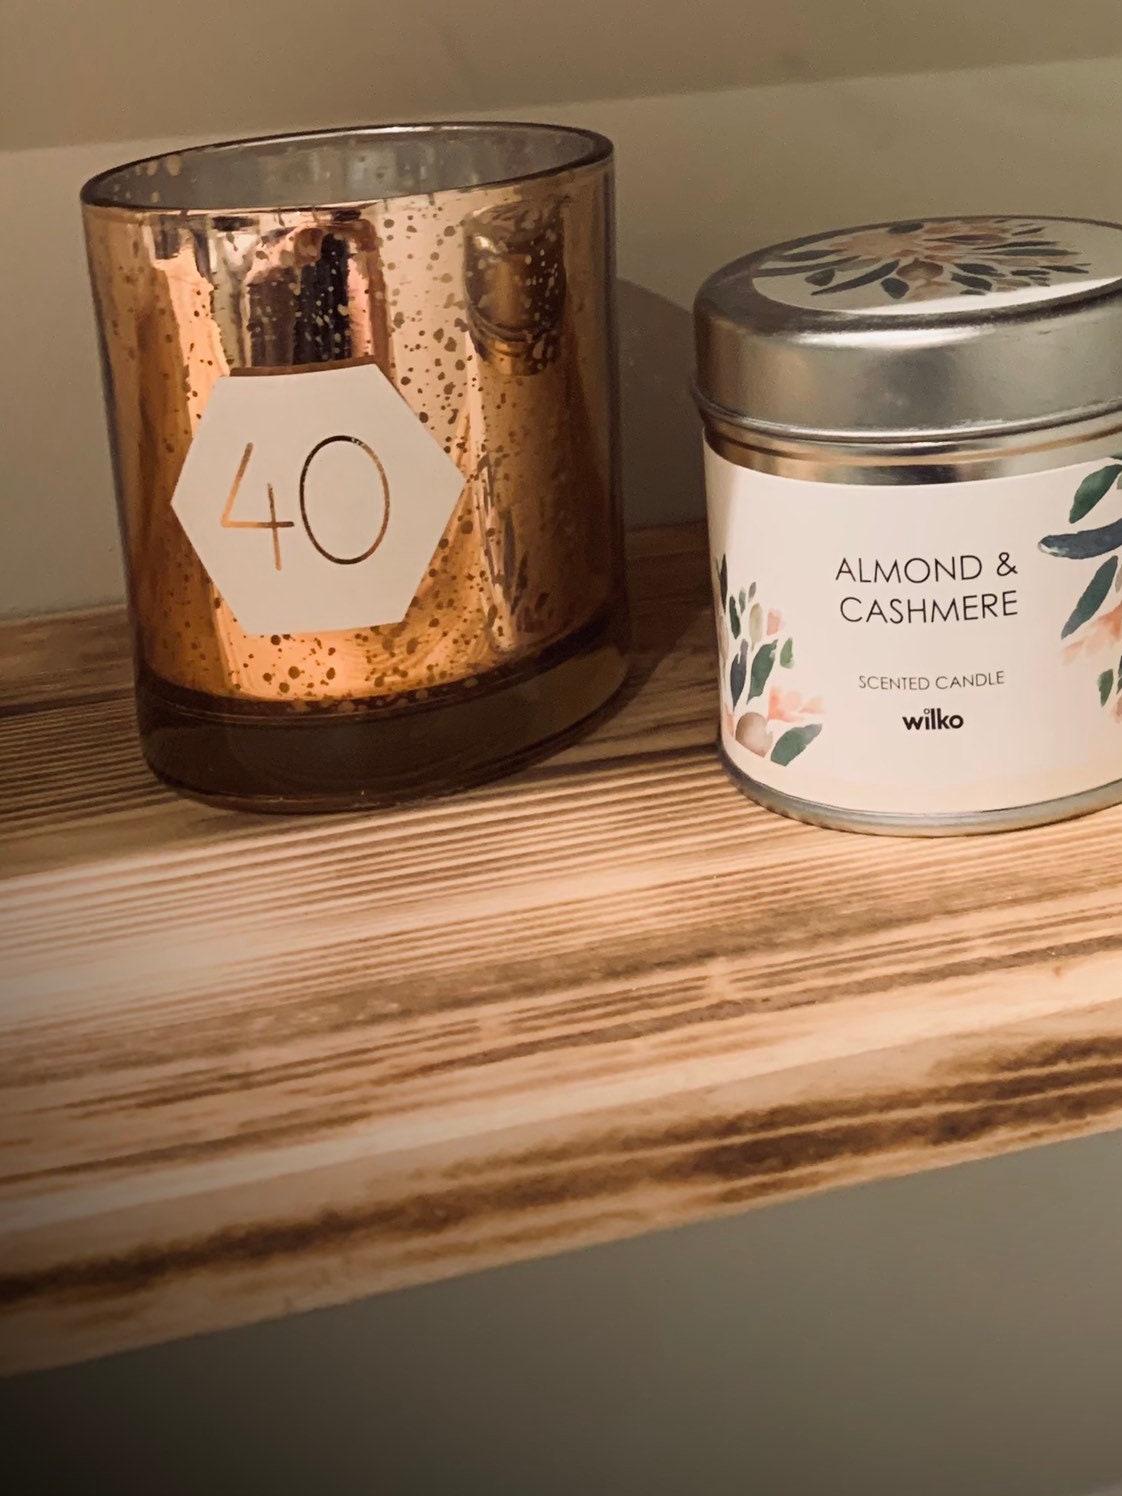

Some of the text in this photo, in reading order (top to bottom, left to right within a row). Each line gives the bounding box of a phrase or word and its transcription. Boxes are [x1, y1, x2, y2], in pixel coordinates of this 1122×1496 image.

[220, 435, 391, 571] 40
[835, 551, 1019, 584] ALMOND &
[840, 590, 1019, 625] CASHMERE
[858, 671, 1005, 691] SCENTED CANDLE
[902, 707, 965, 731] wilko
